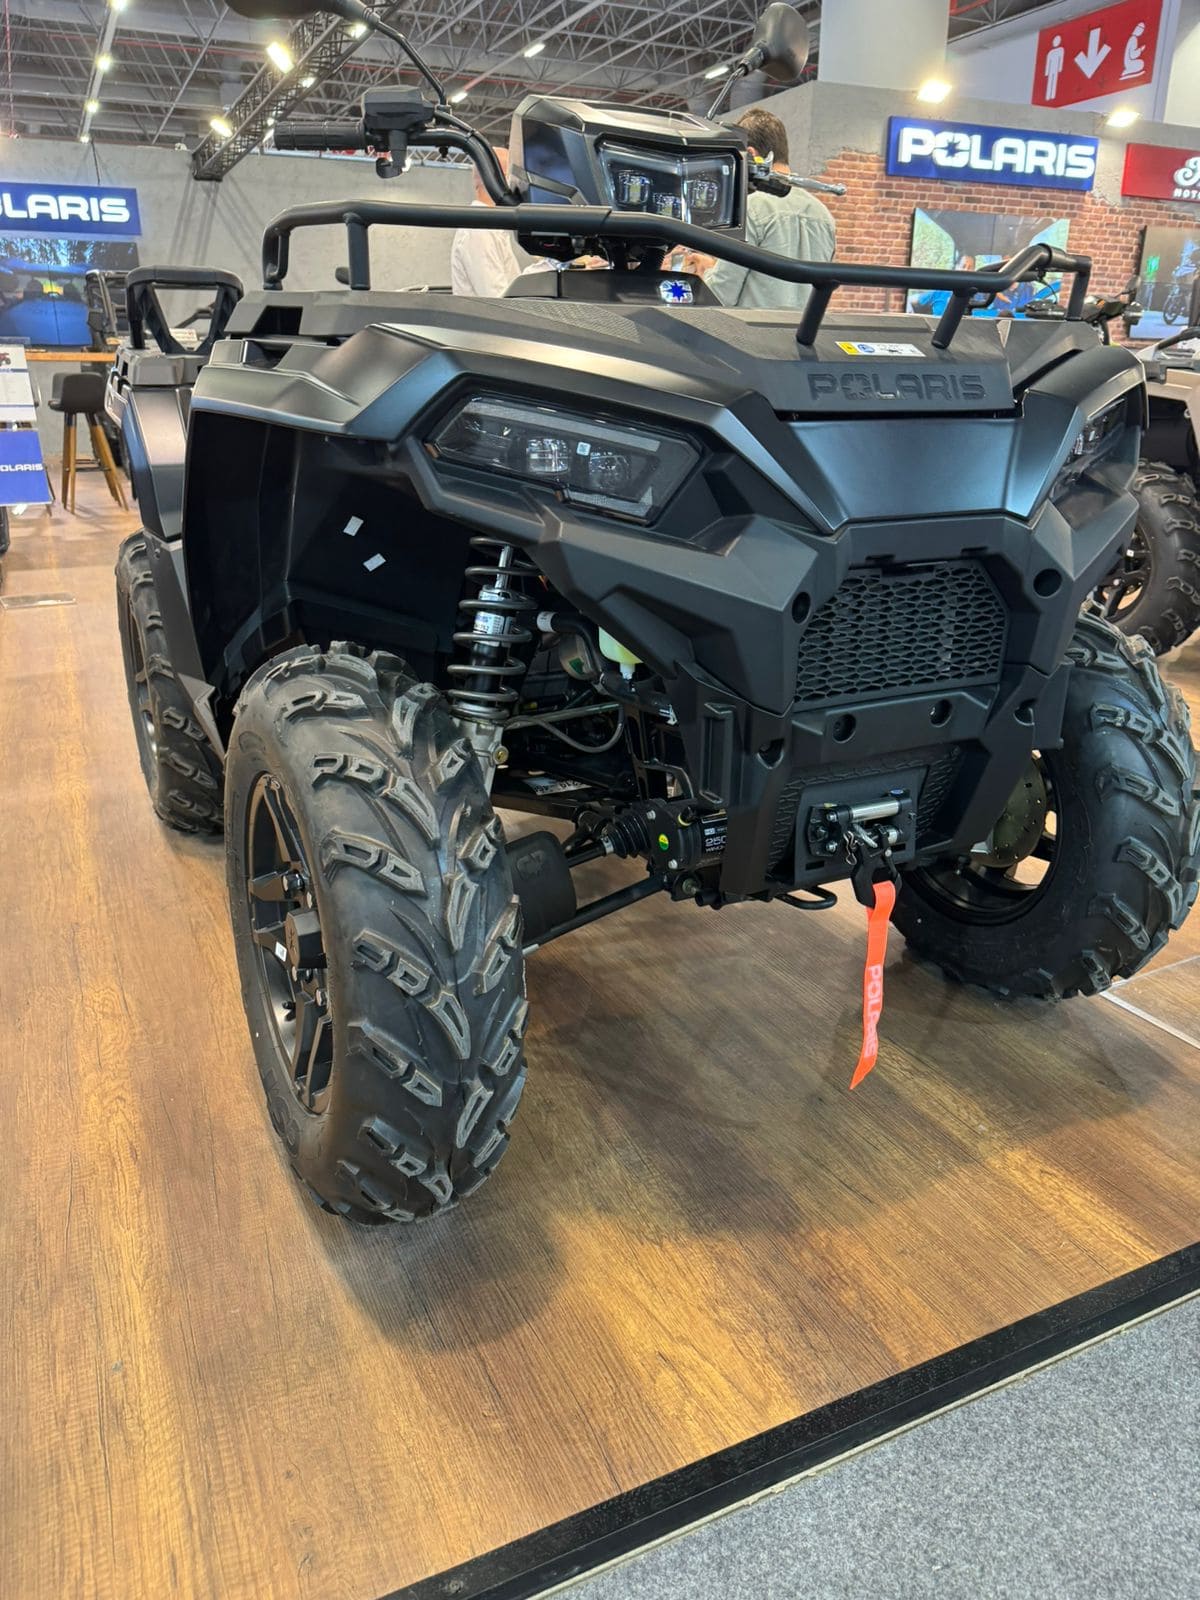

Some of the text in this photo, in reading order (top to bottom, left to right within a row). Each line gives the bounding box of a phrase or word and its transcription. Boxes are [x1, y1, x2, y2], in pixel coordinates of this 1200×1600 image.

[898, 127, 1095, 179] POLARIS
[0, 193, 130, 222] LARIS
[808, 373, 986, 401] POLARIS
